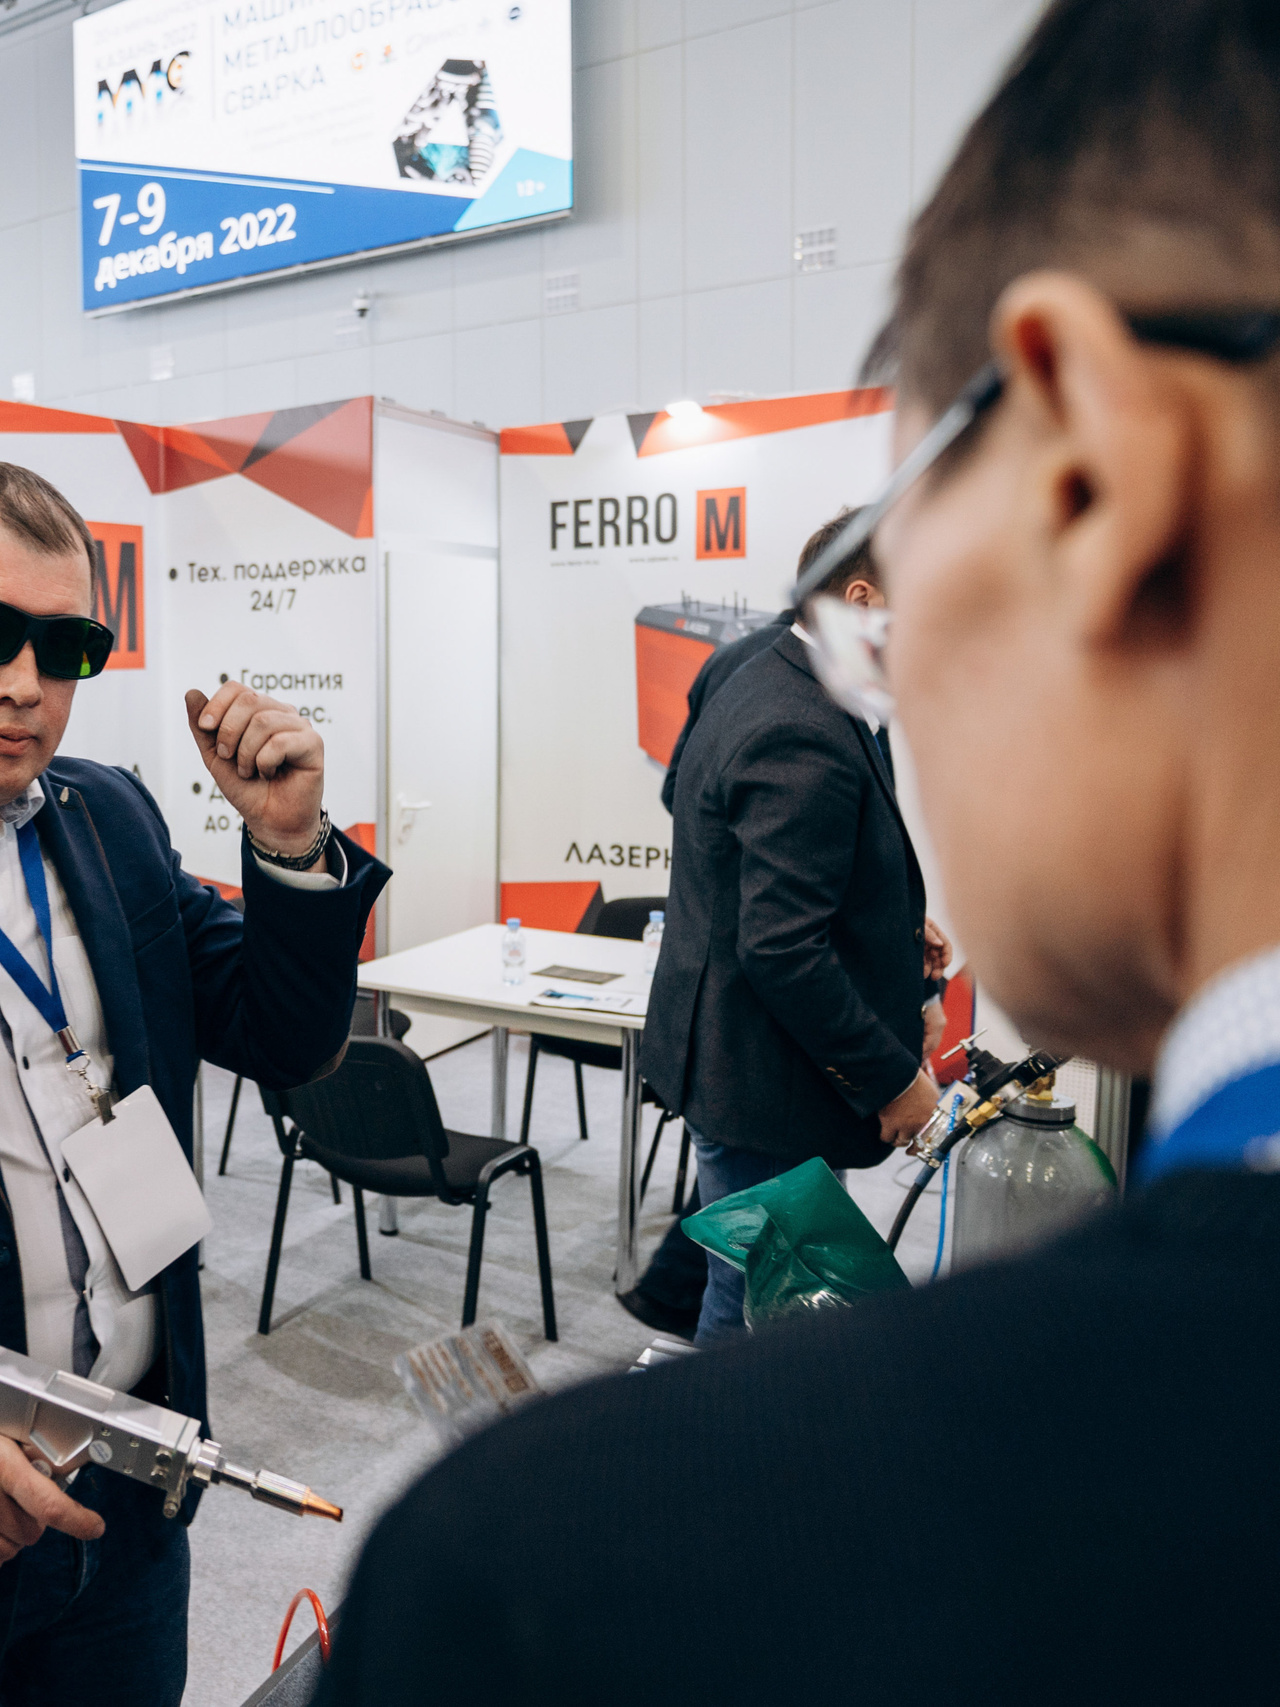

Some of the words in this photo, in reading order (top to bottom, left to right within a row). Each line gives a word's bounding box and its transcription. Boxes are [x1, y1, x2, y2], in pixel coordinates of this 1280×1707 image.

[223, 0, 460, 76] МЕТАЛЛООБРА
[223, 63, 326, 115] СВАРКА
[92, 181, 167, 246] 7-9
[93, 229, 215, 291] декабря
[219, 202, 297, 255] 2022
[550, 492, 678, 551] FERRO
[703, 495, 741, 553] M
[188, 562, 226, 583] Тех.
[233, 555, 366, 581] поддержка
[250, 588, 297, 613] 24/7
[241, 670, 343, 693] Гарантия
[298, 706, 332, 723] ес.
[204, 814, 230, 834] до
